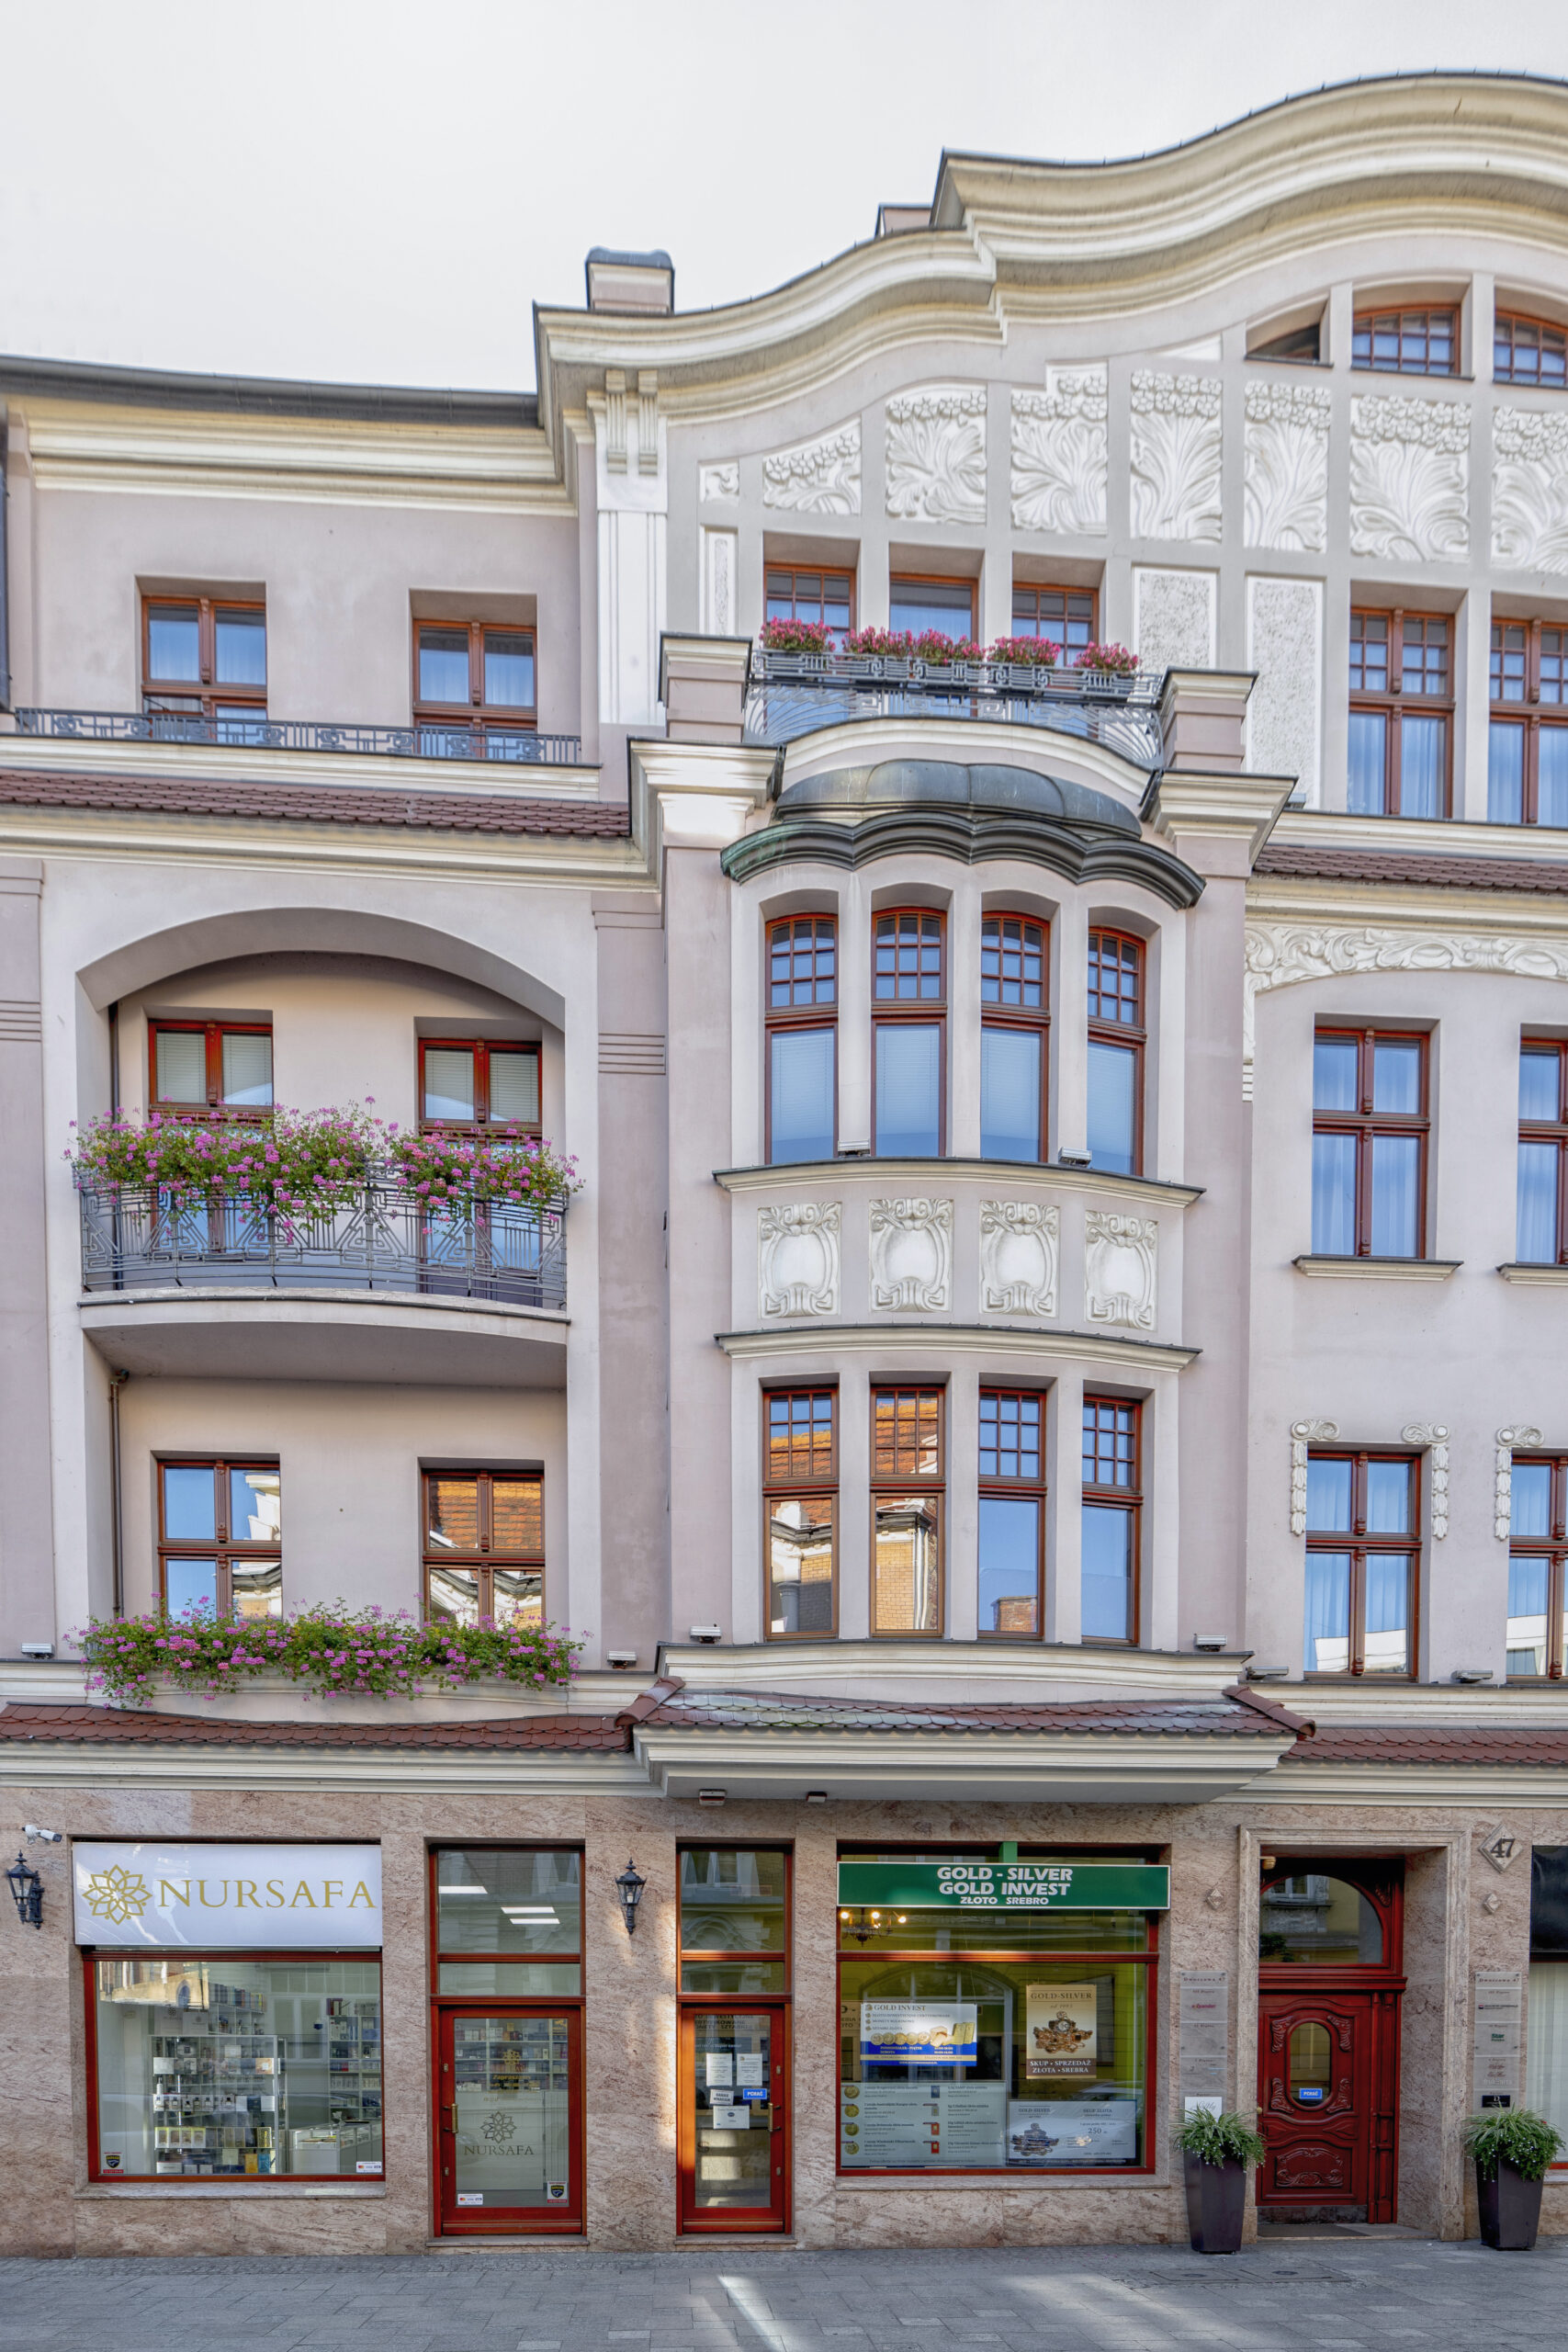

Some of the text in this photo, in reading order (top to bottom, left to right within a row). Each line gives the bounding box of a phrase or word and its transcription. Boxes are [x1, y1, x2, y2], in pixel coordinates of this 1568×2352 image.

[1490, 1838, 1516, 1858] 47
[937, 1867, 993, 1880] GOLD
[1007, 1867, 1073, 1881] SILVER
[154, 1879, 378, 1909] NURSAFA
[939, 1881, 1071, 1895] GOLD INVEST
[960, 1896, 1049, 1905] ZŁOTO SREBRO
[464, 2145, 535, 2155] NURSAFA
